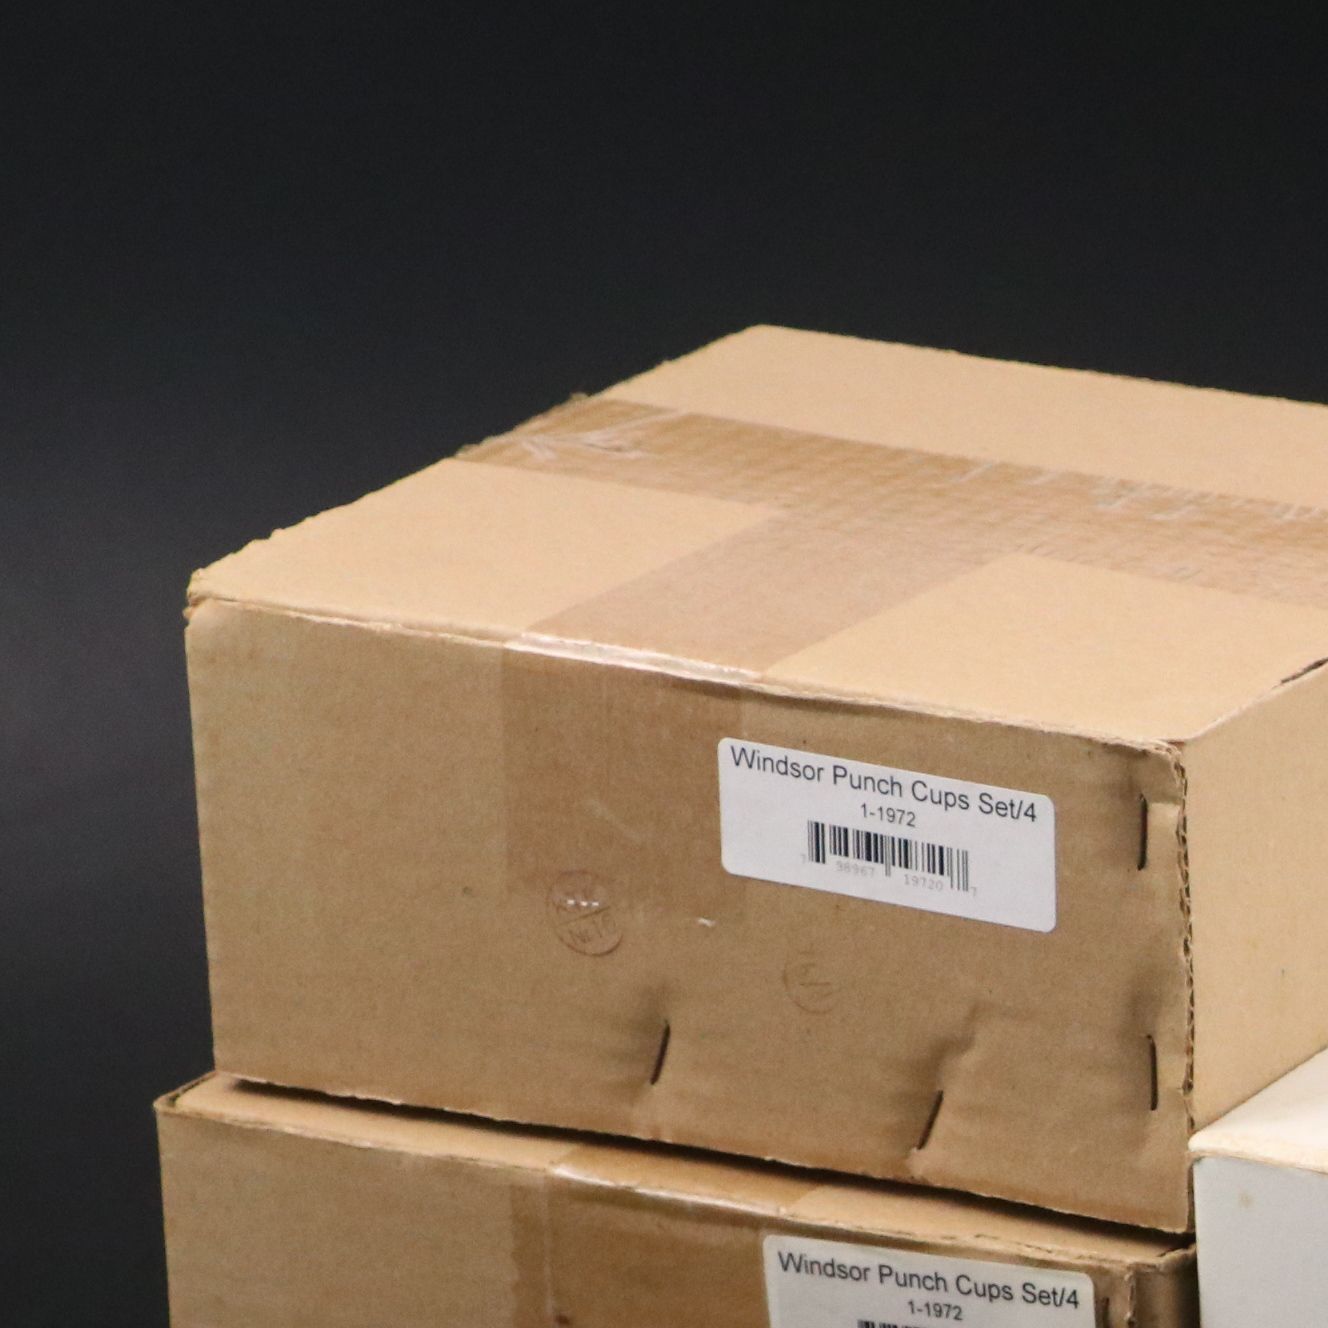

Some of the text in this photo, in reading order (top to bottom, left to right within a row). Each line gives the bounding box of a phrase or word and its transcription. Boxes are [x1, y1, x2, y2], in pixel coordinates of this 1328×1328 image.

[731, 746, 1037, 822] Windsor Punch Cups Set/4
[860, 804, 916, 827] 1-1972
[904, 874, 943, 891] 19720
[778, 1252, 1079, 1308] Windsor Punch Cups Set/4
[908, 1301, 963, 1321] 1-1972
